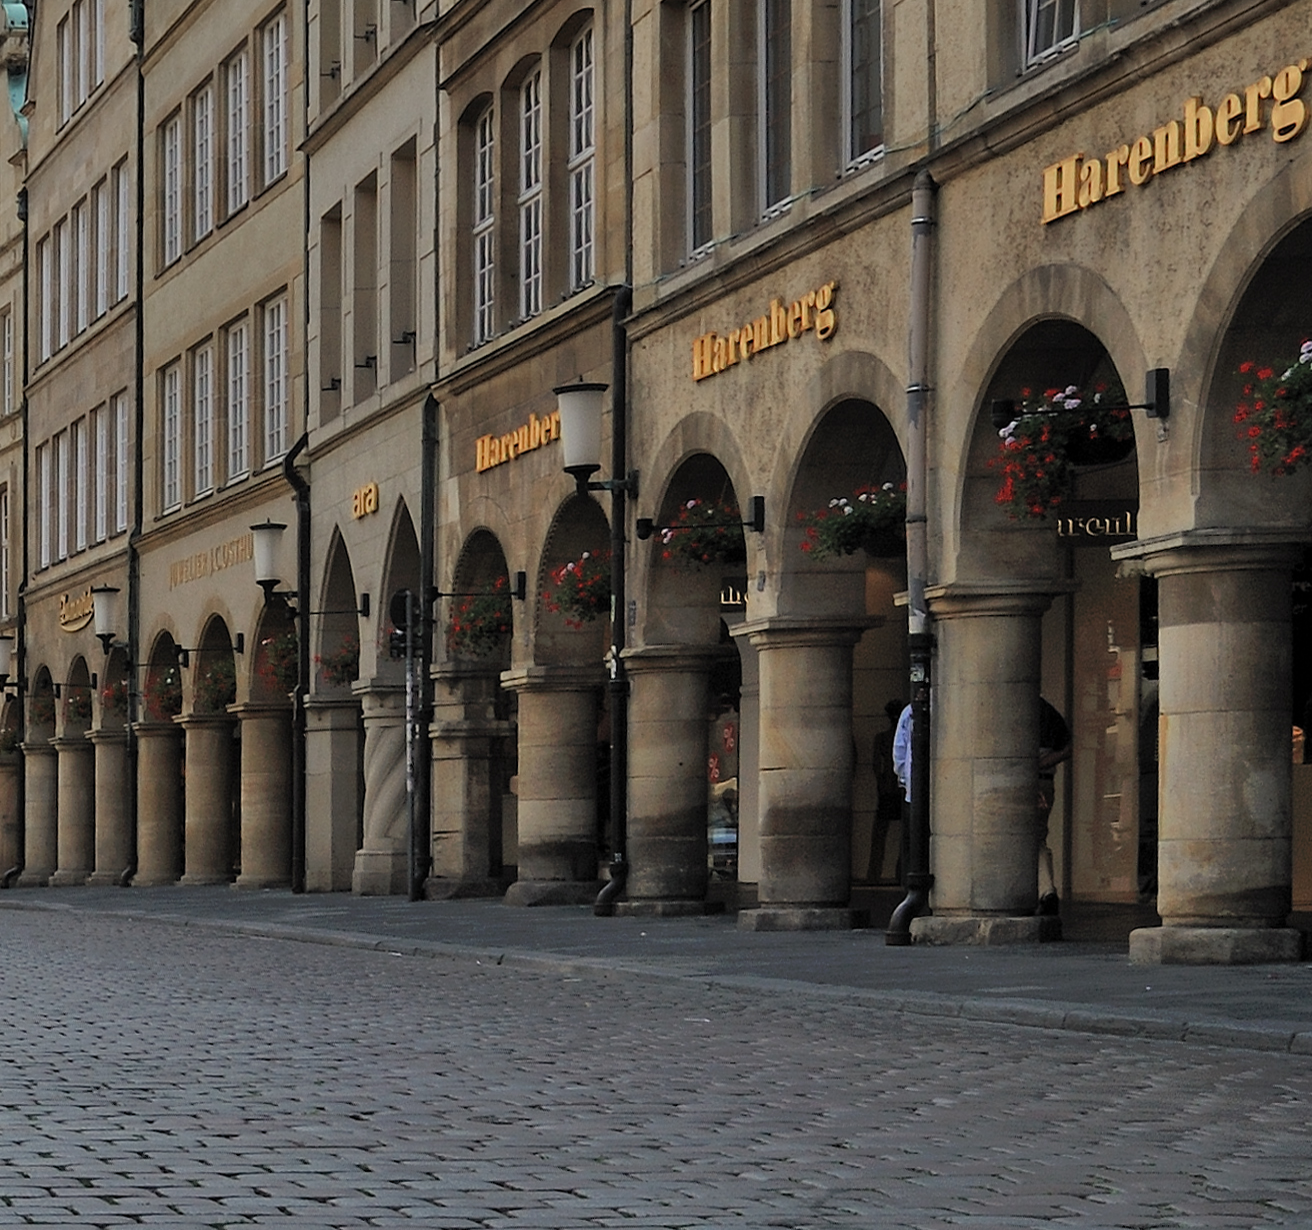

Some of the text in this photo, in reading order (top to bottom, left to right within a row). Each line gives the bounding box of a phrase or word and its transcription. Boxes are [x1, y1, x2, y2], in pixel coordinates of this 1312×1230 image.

[1040, 58, 1312, 225] Harenberg
[692, 280, 839, 382] Harenberg
[352, 481, 379, 520] ara
